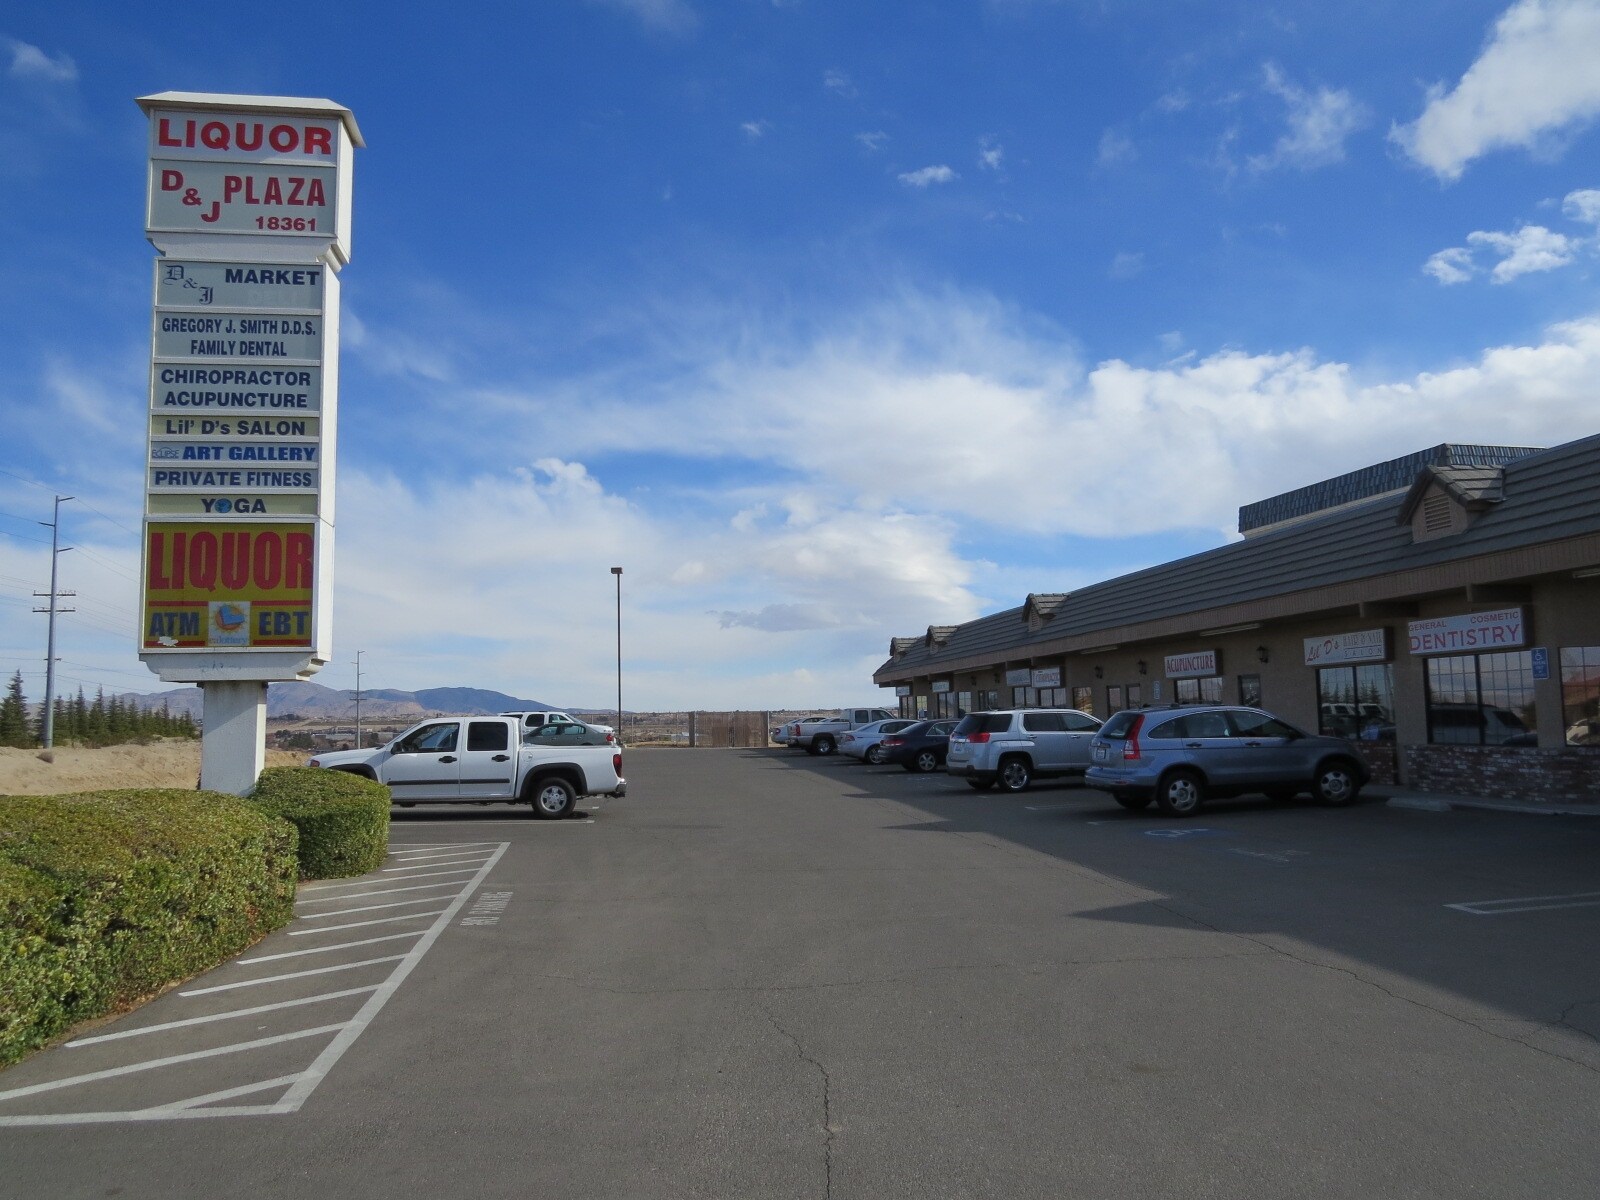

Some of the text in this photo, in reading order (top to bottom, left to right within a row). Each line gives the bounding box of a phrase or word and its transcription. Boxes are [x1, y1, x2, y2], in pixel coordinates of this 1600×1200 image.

[158, 118, 332, 155] LIQUOR
[223, 175, 326, 207] PLAZA
[255, 216, 316, 231] 18361
[225, 268, 320, 285] MARKET
[162, 317, 316, 336] GREGORY J. SMITH D.D.S.
[190, 339, 287, 357] FAMILY DENTAL
[161, 368, 311, 386] CHIROPRACTOR
[164, 391, 308, 408] ACUPUNCTURE
[166, 419, 306, 436] Lil' D's SALON
[152, 446, 317, 461] ECLIPSE ART GALLERY
[155, 471, 312, 487] PRIVATE FITNESS
[201, 498, 267, 514] YOGA
[150, 531, 314, 593] LIQUOR
[150, 611, 310, 637] ATM EBT
[1408, 610, 1519, 632] GENERAL COSMETIC
[1408, 623, 1520, 652] DENTISTRY
[1166, 654, 1214, 673] ACUPUNCTURE
